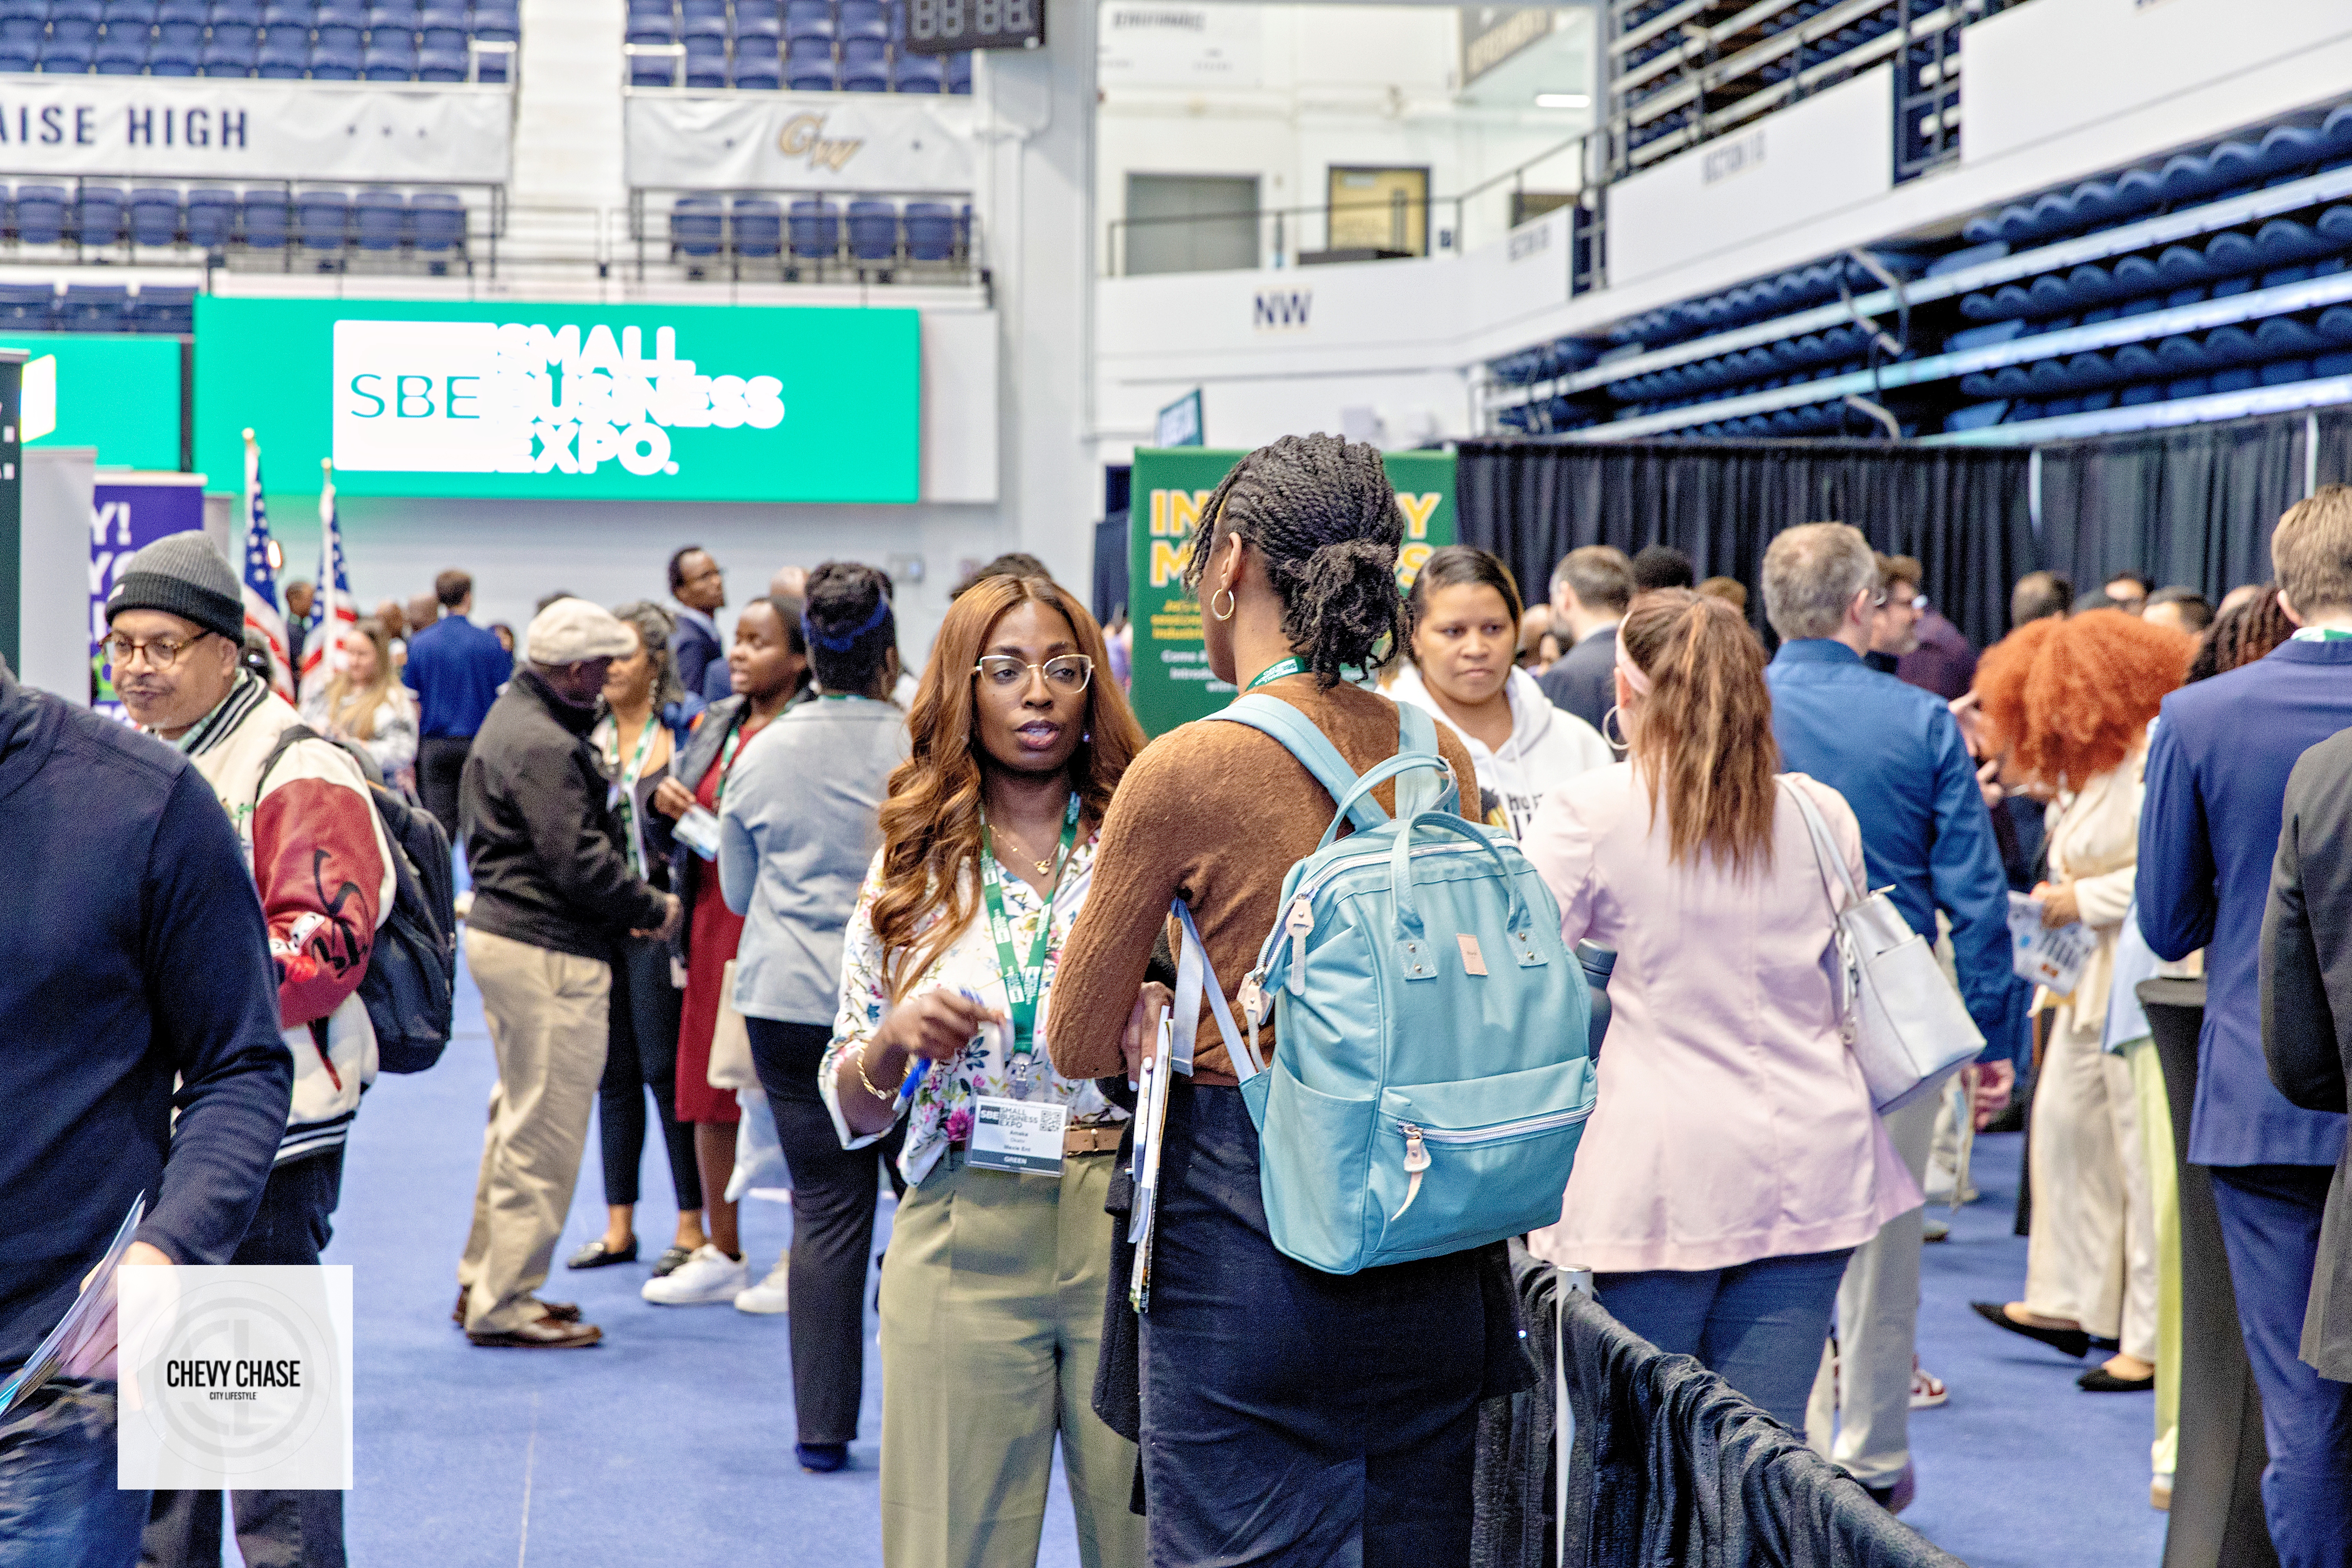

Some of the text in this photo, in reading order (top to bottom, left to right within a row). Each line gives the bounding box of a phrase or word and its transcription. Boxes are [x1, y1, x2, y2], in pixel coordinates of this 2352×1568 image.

[128, 107, 249, 148] HIGH
[1253, 289, 1312, 327] NW
[496, 323, 697, 379] SMALL
[350, 374, 480, 419] SBE
[497, 373, 784, 429] BUSINESS
[980, 1110, 999, 1120] SBE
[1000, 1107, 1026, 1115] SMALL
[1000, 1113, 1038, 1123] BUSINESS
[1000, 1119, 1022, 1128] EXPO
